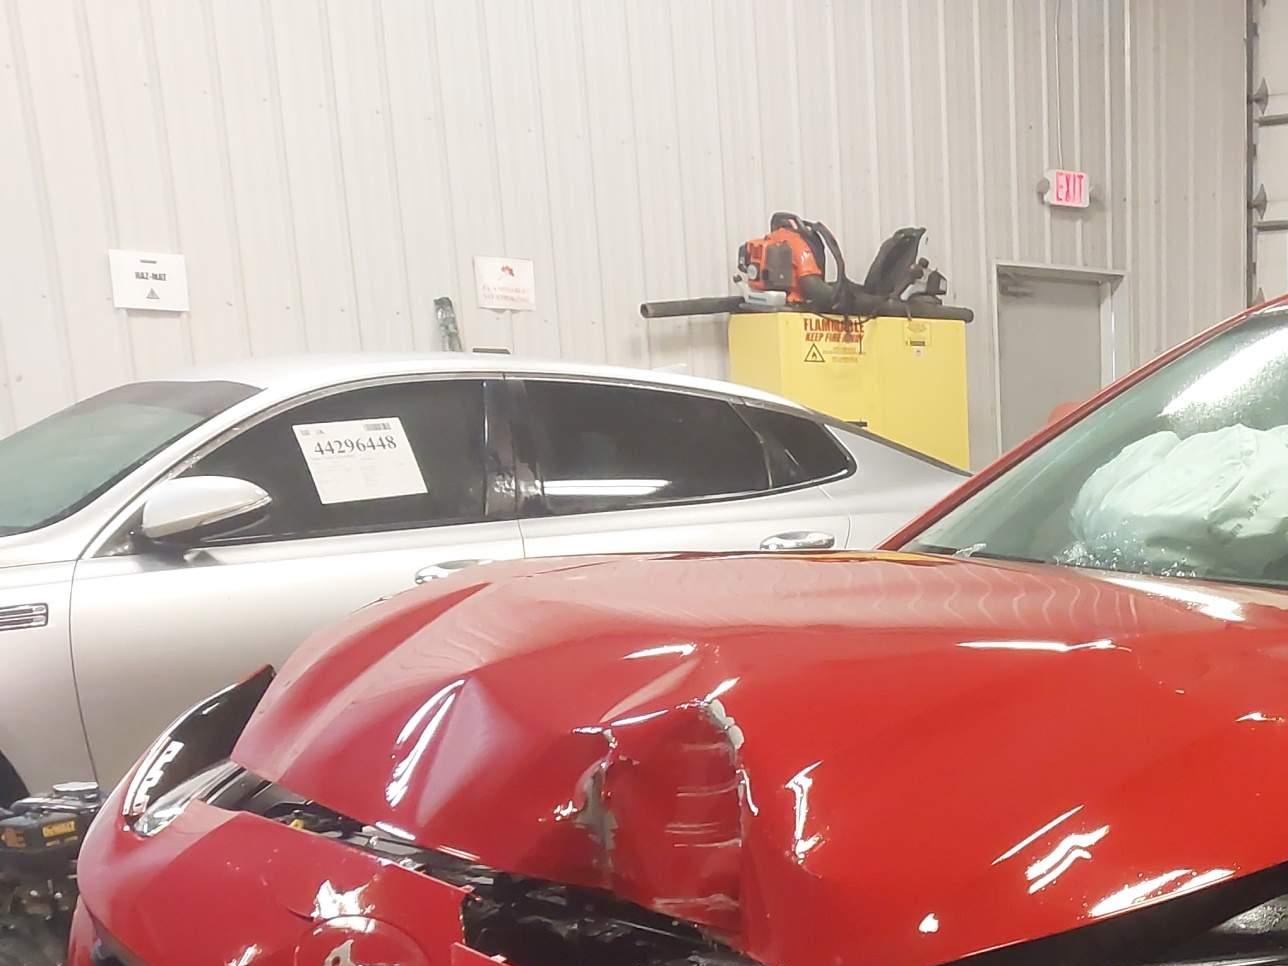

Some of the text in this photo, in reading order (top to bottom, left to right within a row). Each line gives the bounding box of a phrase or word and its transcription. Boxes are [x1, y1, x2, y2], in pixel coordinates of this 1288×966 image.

[1056, 172, 1084, 203] EXIT
[805, 332, 824, 341] KEEP
[314, 435, 396, 455] 44296448
